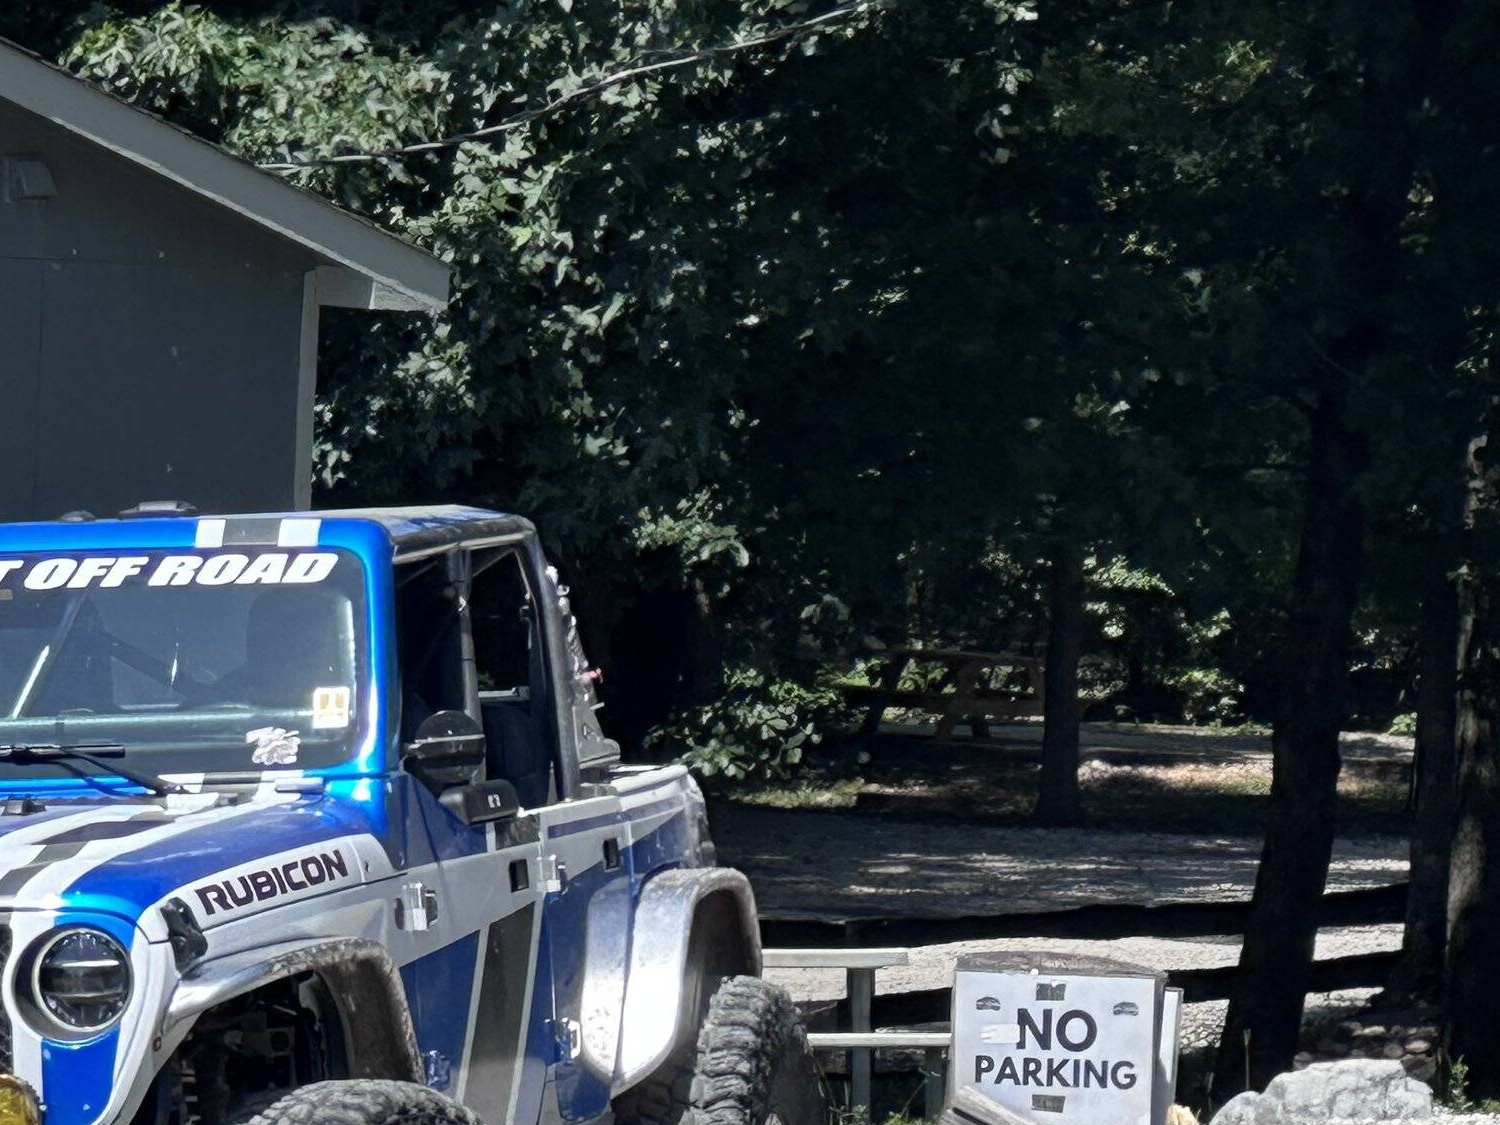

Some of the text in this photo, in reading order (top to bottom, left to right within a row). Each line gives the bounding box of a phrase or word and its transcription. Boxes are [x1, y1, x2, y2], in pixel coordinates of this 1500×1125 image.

[23, 556, 149, 590] OFF
[148, 553, 339, 587] ROAD
[194, 849, 349, 916] RUBICON
[1016, 1007, 1098, 1053] NO
[974, 1054, 1138, 1090] PARKING
